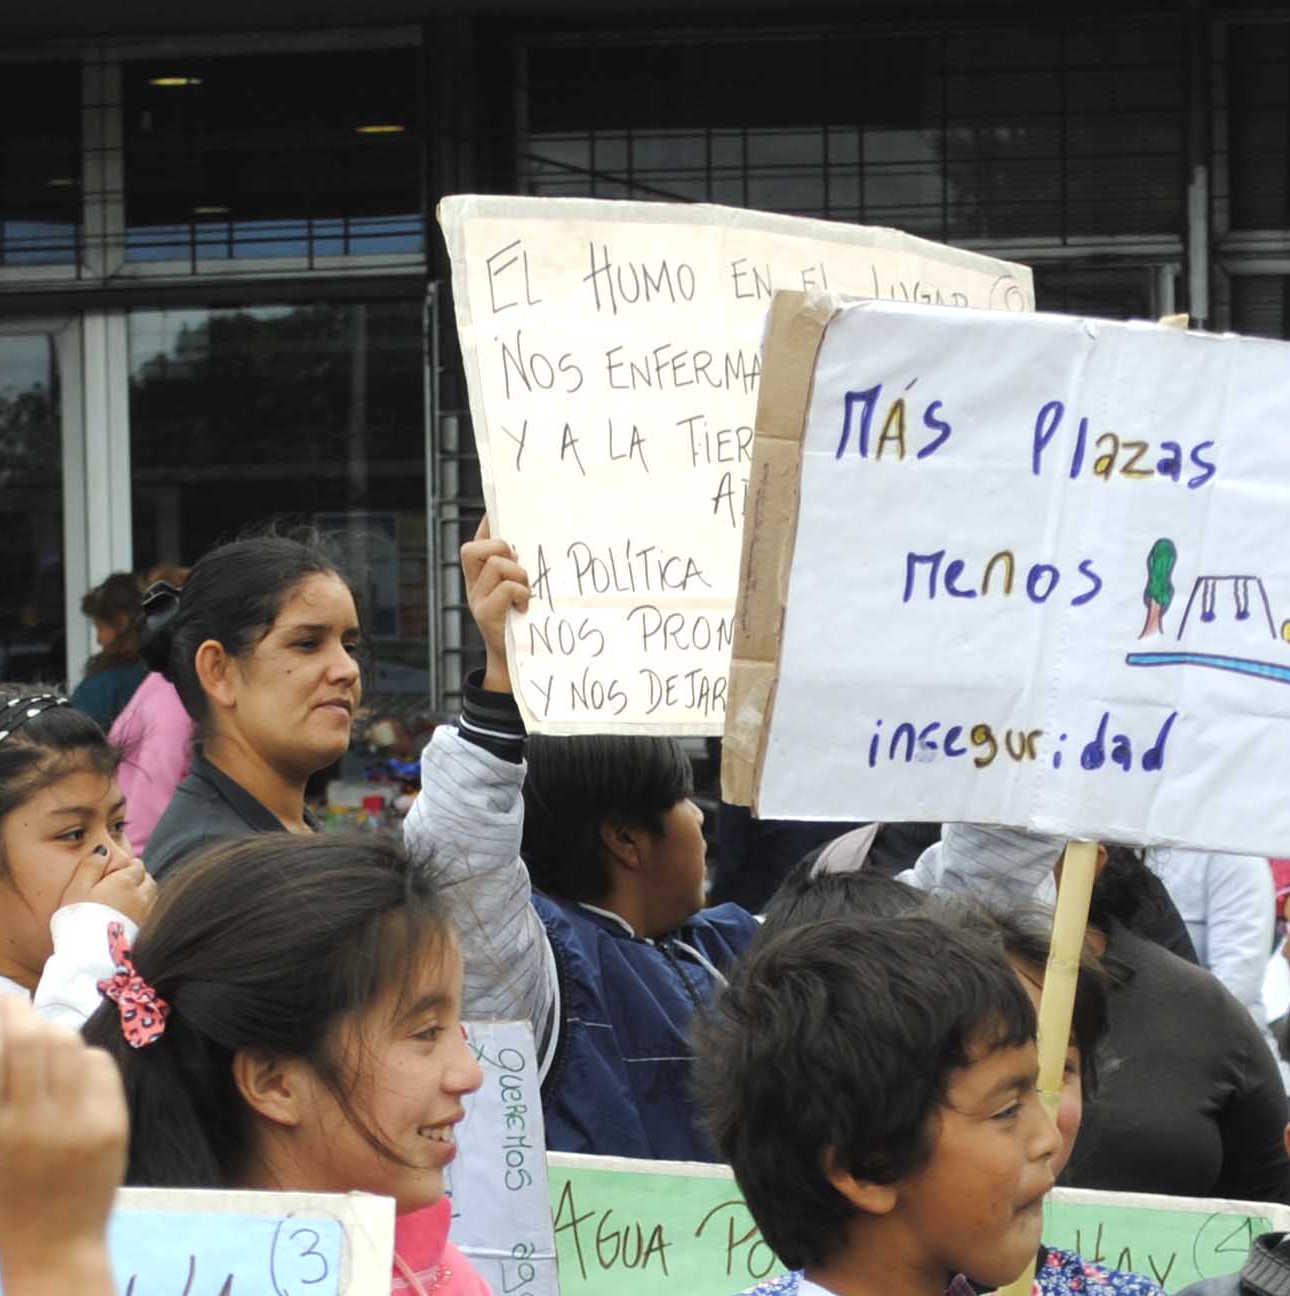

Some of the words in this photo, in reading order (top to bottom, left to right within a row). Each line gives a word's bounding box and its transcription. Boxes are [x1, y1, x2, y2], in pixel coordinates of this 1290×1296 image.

[486, 241, 541, 315] EL
[583, 241, 696, 315] HUMO
[731, 257, 773, 299] EN
[494, 331, 584, 400] NOS
[501, 420, 528, 476] Y
[560, 423, 586, 476] A
[607, 419, 648, 474] LA
[836, 378, 952, 461] MÁS
[529, 615, 605, 658] NOS
[532, 675, 555, 716] Y
[570, 671, 627, 714] NOS
[869, 711, 1178, 774] inseguridad
[290, 1228, 329, 1285] 3
[554, 1179, 672, 1281] AGUA
